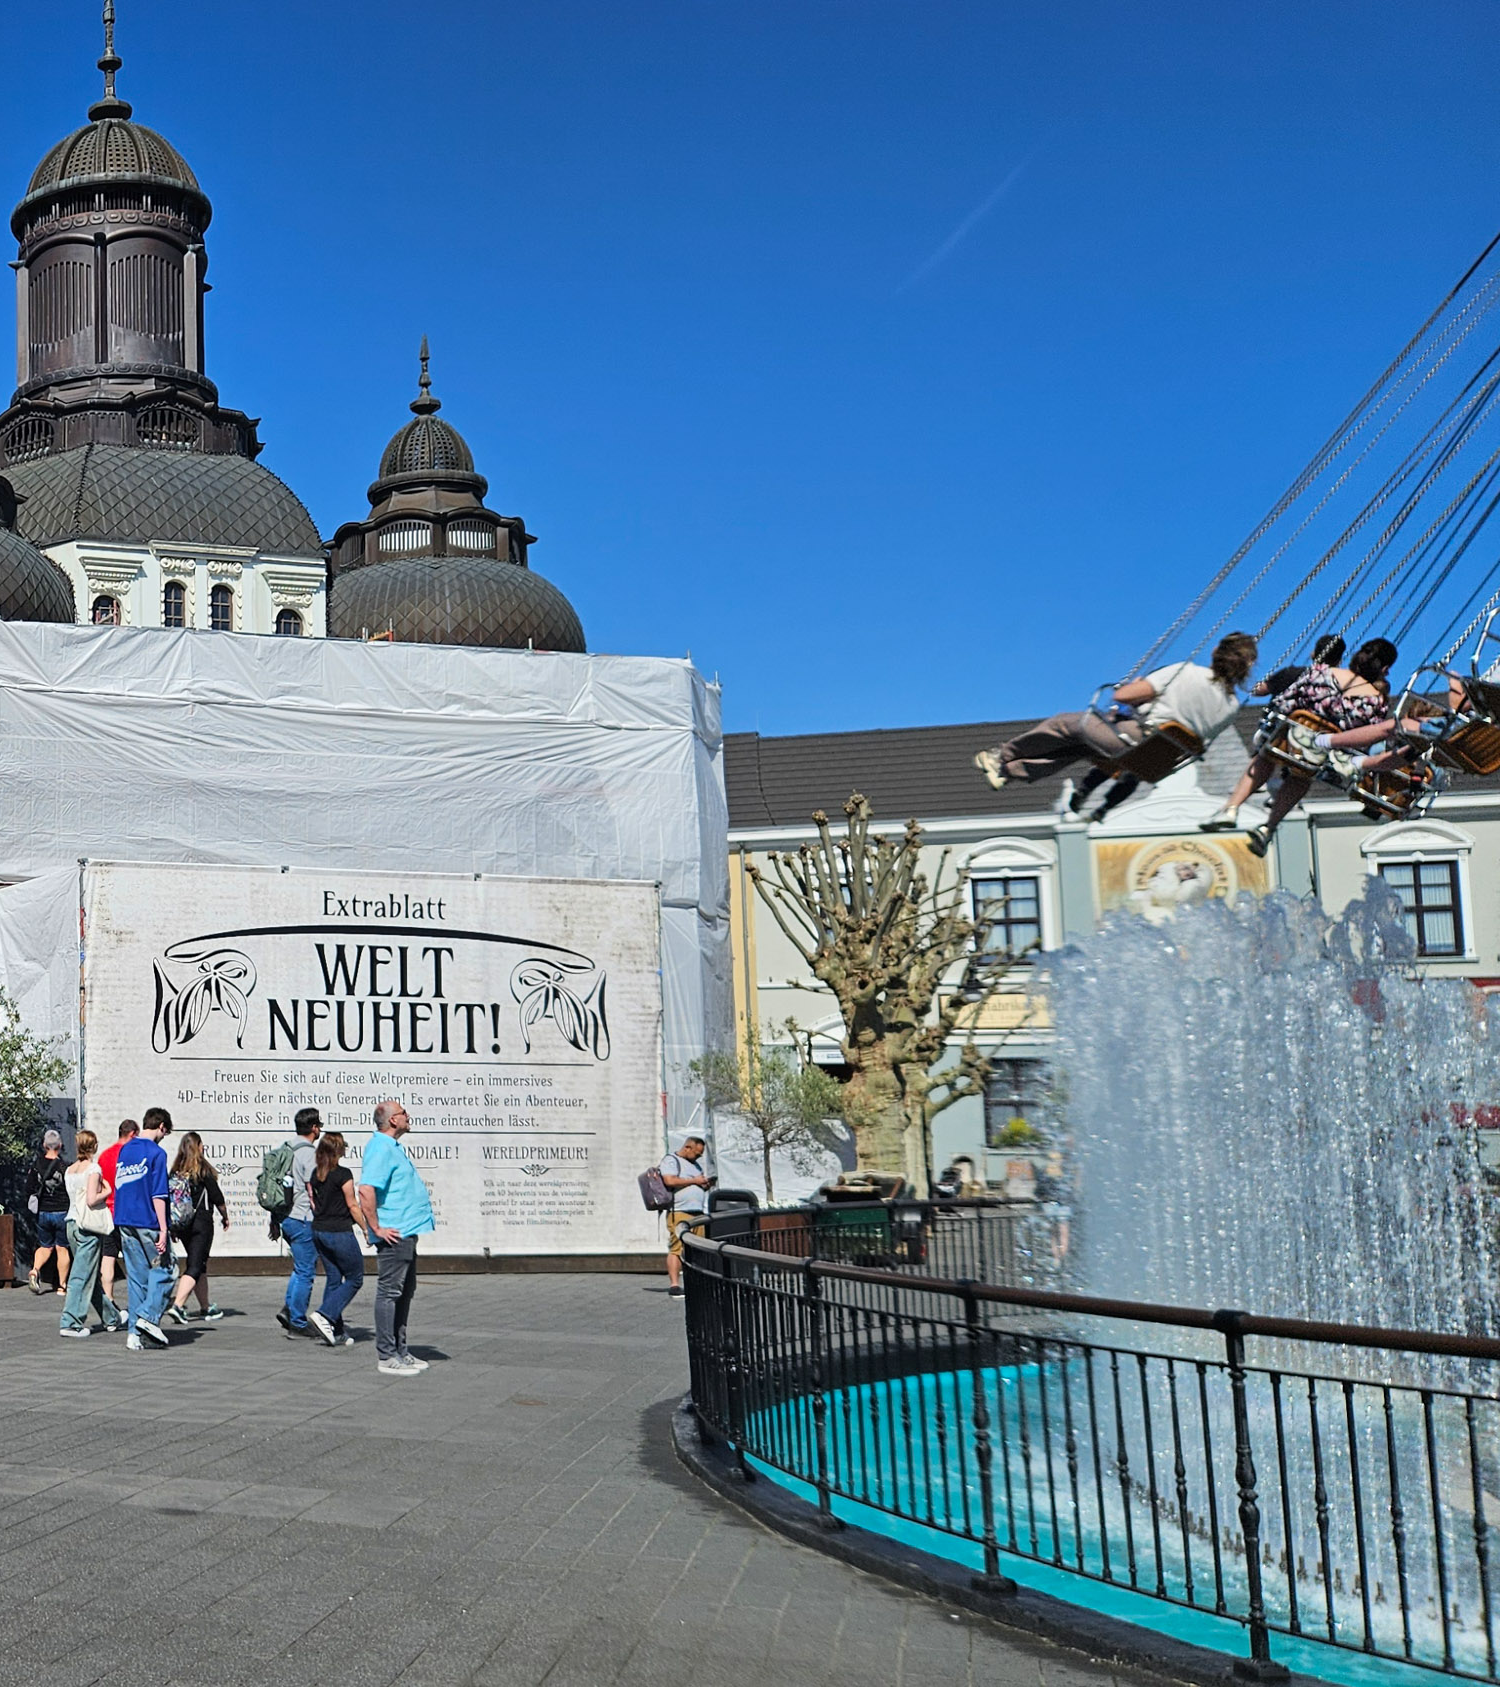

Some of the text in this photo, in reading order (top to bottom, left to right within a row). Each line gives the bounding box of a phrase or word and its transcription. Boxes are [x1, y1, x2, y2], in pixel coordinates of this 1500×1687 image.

[322, 890, 447, 920] Extrablatt
[314, 943, 454, 999] WELT
[267, 999, 501, 1055] NEUHEIT!
[214, 1069, 255, 1083] Freuen
[260, 1070, 278, 1083] Sie
[283, 1070, 306, 1084] sich
[311, 1071, 331, 1084] auf
[335, 1071, 365, 1085] diese
[369, 1072, 449, 1088] Weltpremiere
[466, 1074, 484, 1086] ein
[488, 1074, 553, 1087] immersives
[254, 1091, 274, 1104] der
[278, 1091, 332, 1105] nächsten
[411, 1092, 423, 1105] Es
[428, 1095, 479, 1106] erwartet
[484, 1093, 499, 1106] Sie
[504, 1094, 521, 1107] ein
[525, 1095, 588, 1109] Abenteuer,
[229, 1112, 250, 1125] das
[255, 1112, 273, 1125] Sie
[278, 1112, 290, 1125] in
[327, 1113, 436, 1126] Film-Dionen
[441, 1114, 504, 1127] eintauchen
[508, 1114, 540, 1127] lässt.
[203, 1145, 226, 1158] RLD
[482, 1146, 588, 1160] WERELDPRIMEUR!
